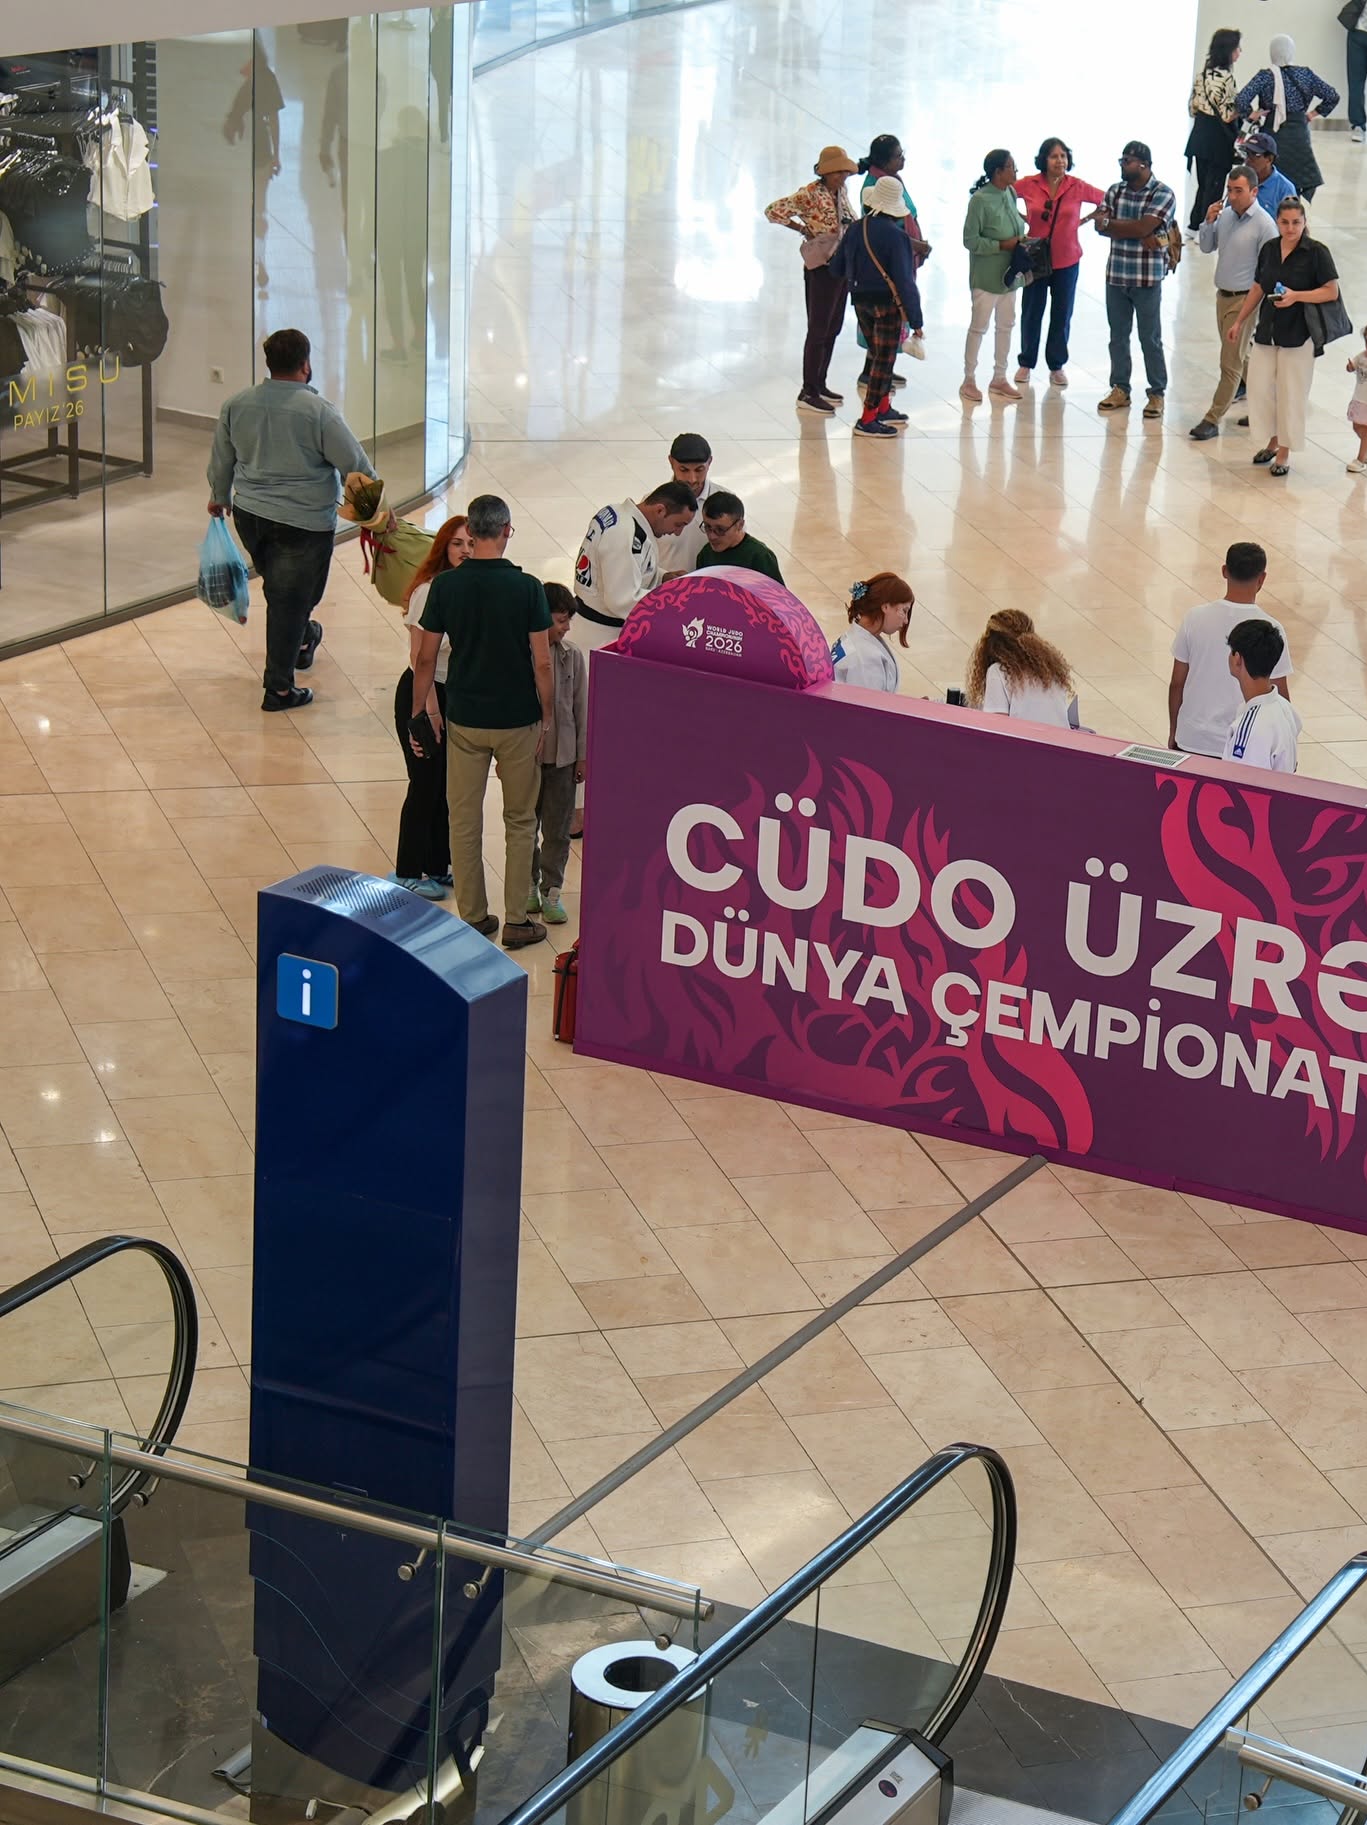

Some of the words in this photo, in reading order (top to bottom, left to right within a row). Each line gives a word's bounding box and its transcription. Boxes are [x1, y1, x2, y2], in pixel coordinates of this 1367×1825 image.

[9, 355, 120, 407] MISU
[14, 400, 84, 432] PAYIZ'26
[705, 635, 743, 653] 2026
[666, 792, 1016, 949] CÜDO
[660, 906, 909, 1015] DÜNYA
